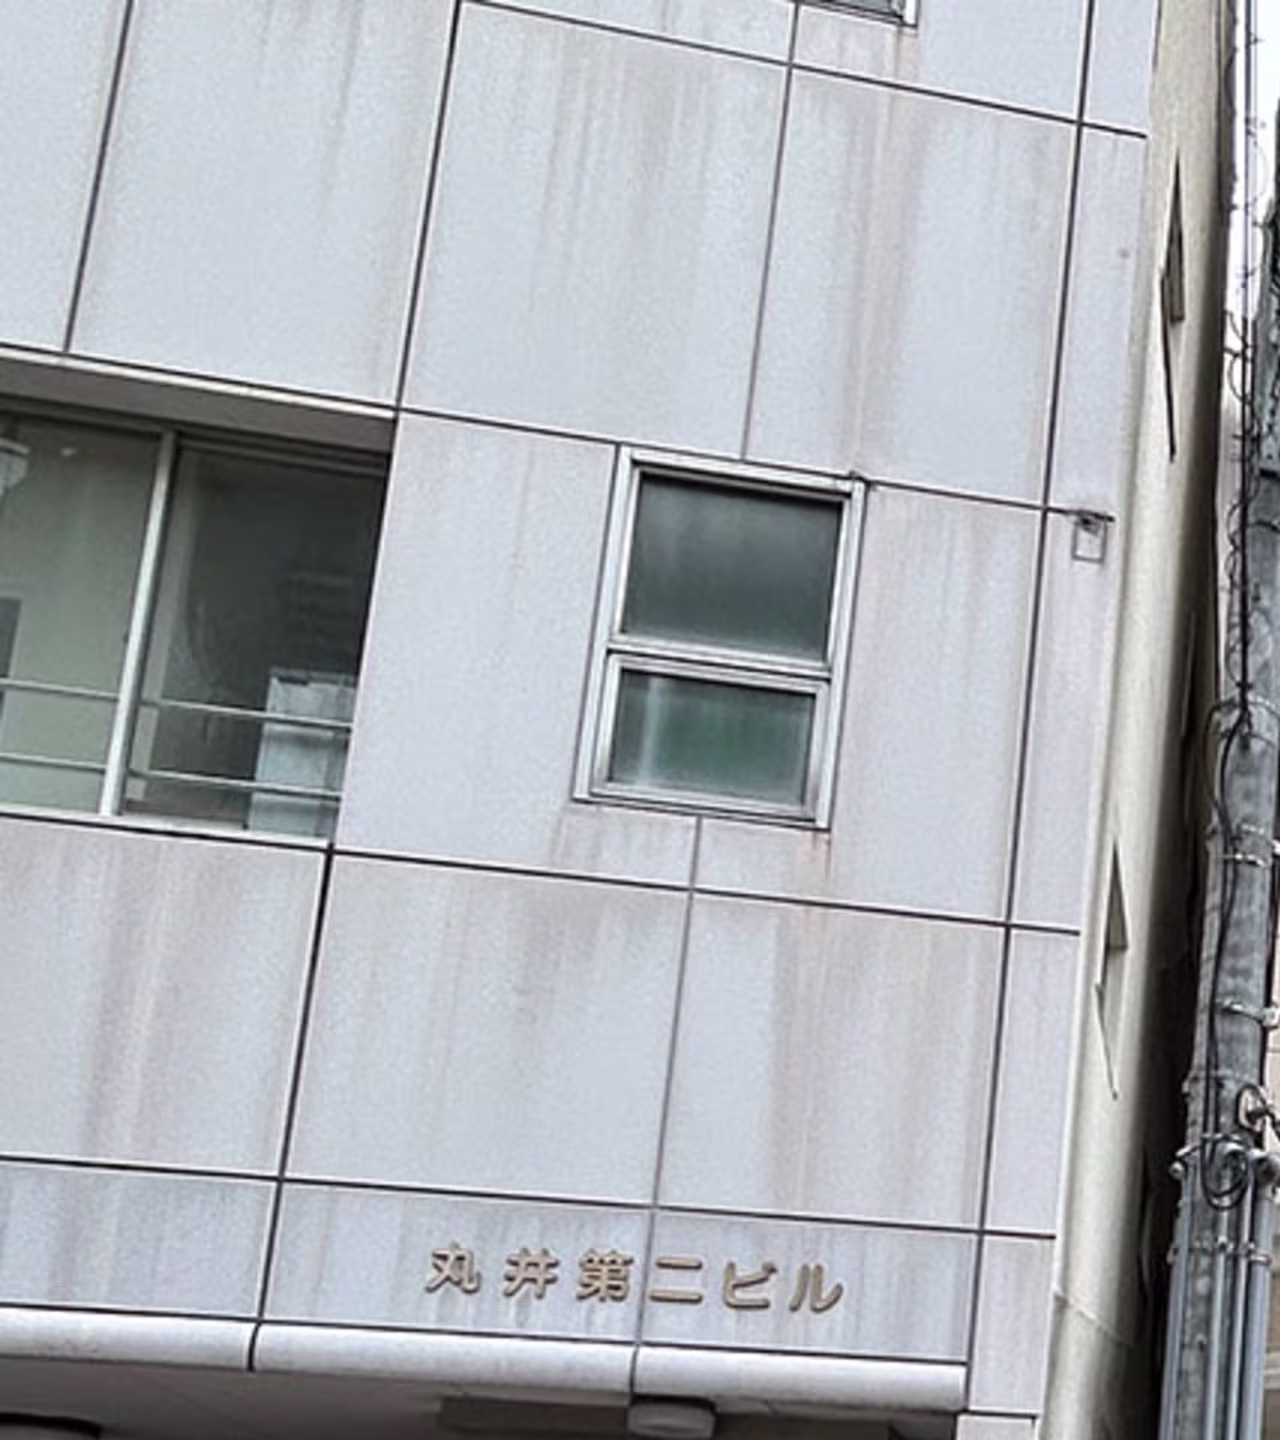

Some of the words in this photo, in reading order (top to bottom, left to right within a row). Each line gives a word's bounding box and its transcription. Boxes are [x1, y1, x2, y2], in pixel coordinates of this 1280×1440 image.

[426, 1240, 844, 1313] 丸井第二ビル
